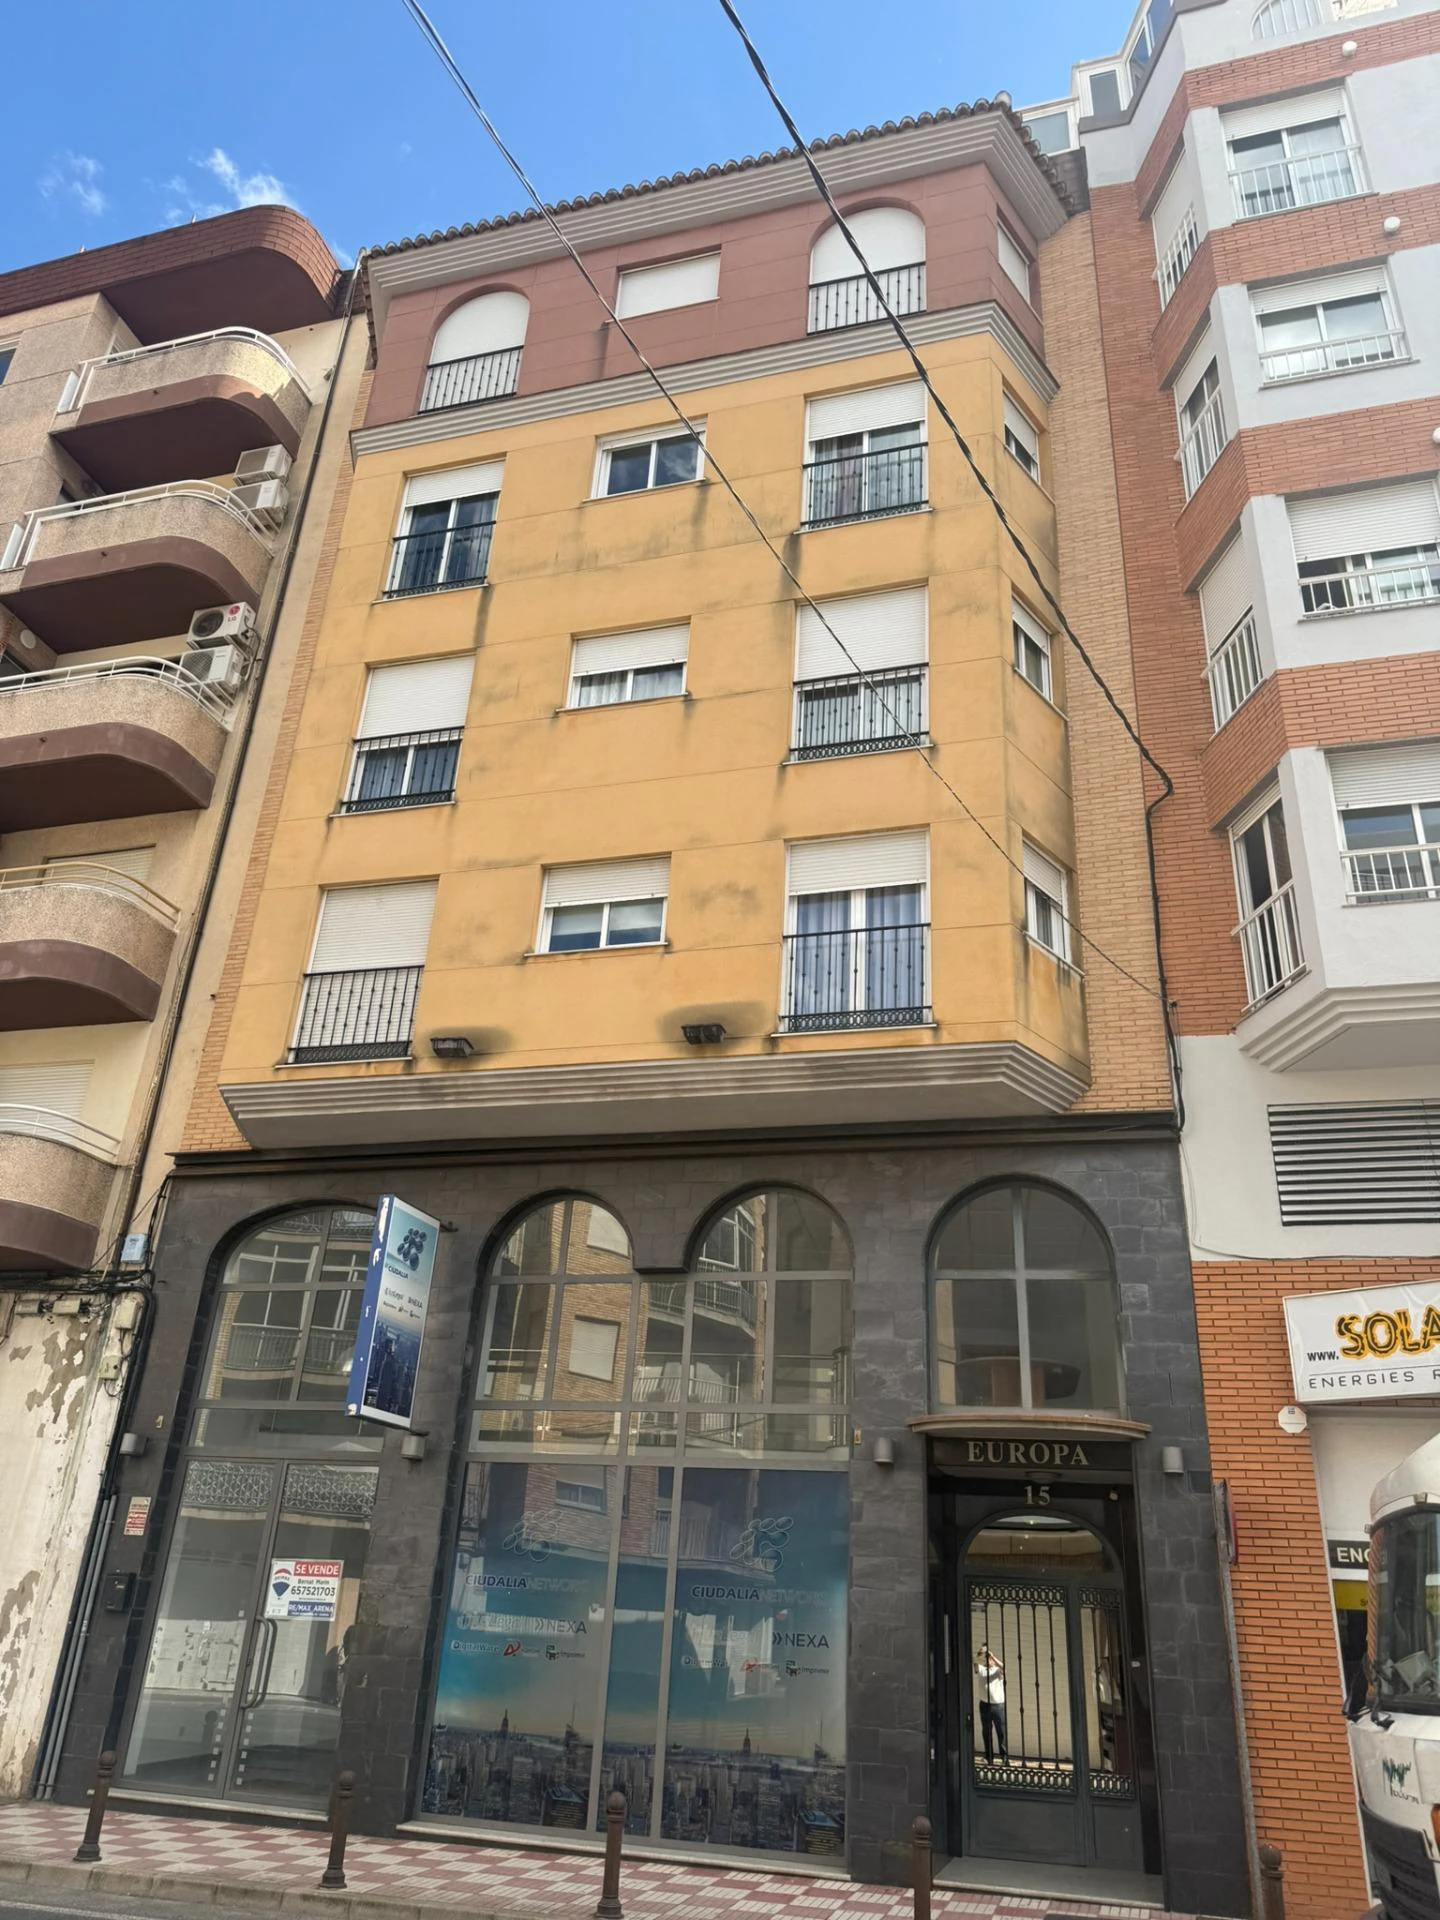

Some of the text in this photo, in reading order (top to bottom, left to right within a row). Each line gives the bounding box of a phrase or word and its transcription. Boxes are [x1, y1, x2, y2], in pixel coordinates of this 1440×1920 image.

[1307, 1350, 1339, 1362] www.
[1308, 1371, 1415, 1389] ENERGIES
[967, 1441, 1089, 1465] EUROPA
[1024, 1485, 1050, 1505] 15
[295, 1564, 339, 1575] SE VENDE
[465, 1575, 527, 1588] CIUDALIA
[291, 1586, 336, 1596] 657521703
[692, 1586, 760, 1601] CIUDALIA
[313, 1604, 334, 1612] ARENA
[546, 1619, 588, 1634] NEXA
[784, 1633, 830, 1649] NEXA
